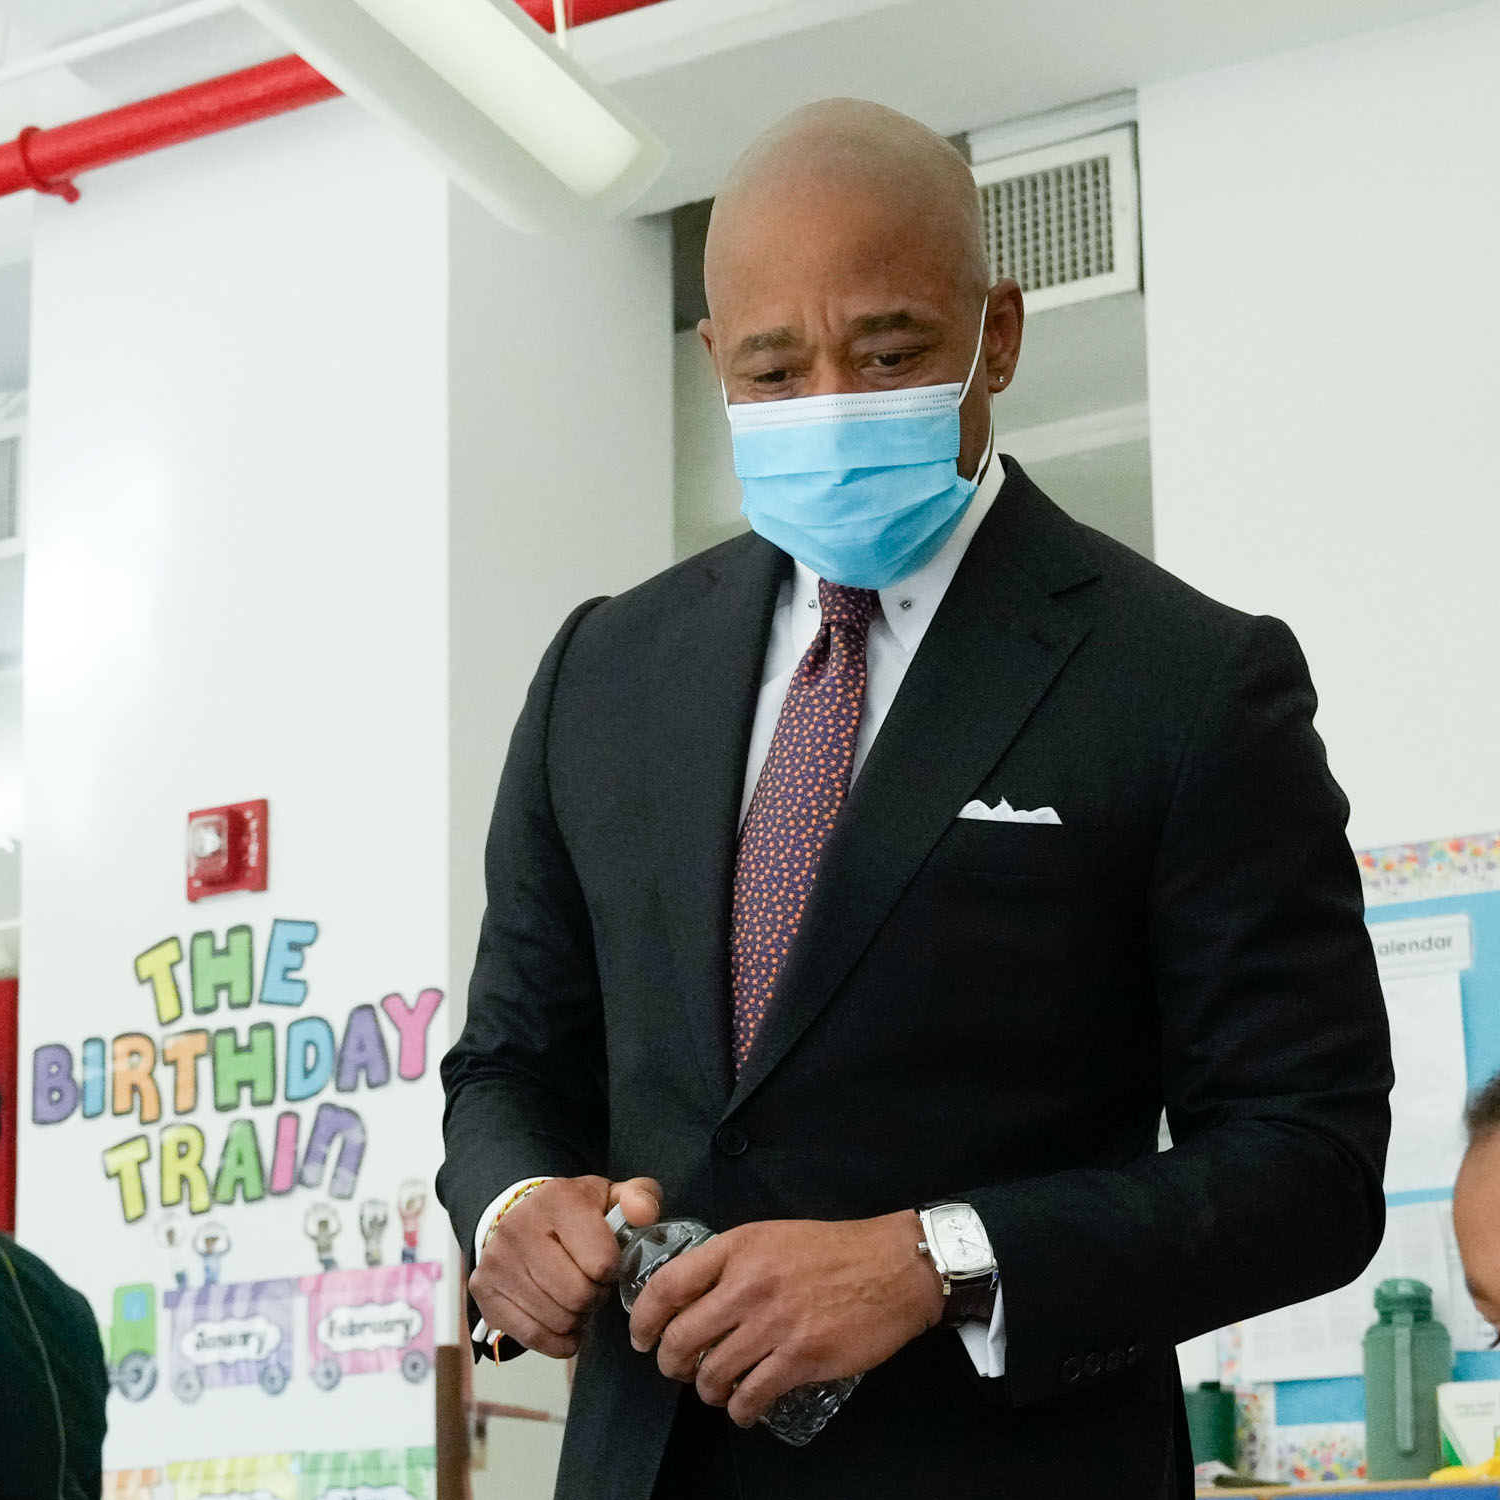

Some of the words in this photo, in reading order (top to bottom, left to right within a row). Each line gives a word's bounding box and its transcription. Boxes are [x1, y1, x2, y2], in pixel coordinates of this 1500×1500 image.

[134, 918, 319, 1026] THE
[1377, 934, 1453, 957] alendar
[31, 988, 445, 1126] BIRTHDAY
[328, 1317, 414, 1348] February
